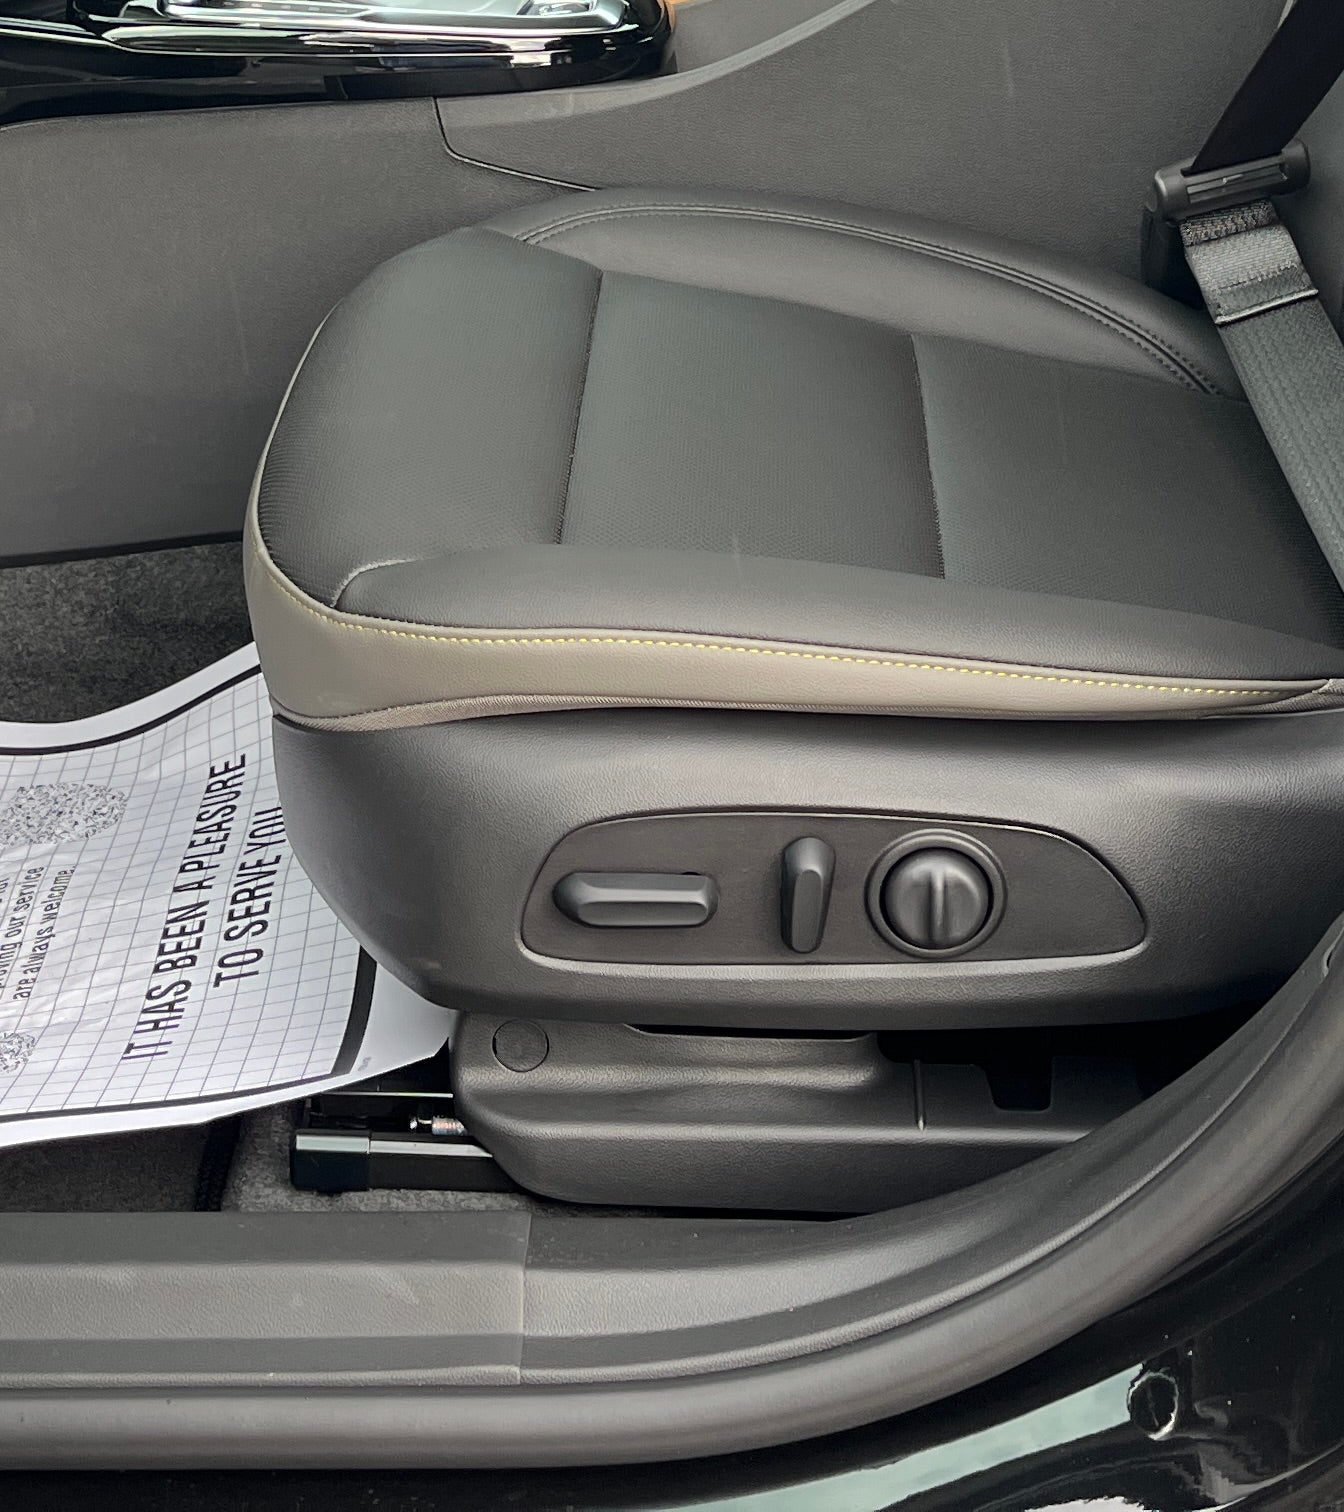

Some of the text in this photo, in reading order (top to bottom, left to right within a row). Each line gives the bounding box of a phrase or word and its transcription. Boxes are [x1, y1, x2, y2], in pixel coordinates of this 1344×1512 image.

[13, 867, 45, 912] service
[121, 754, 247, 1061] IT HAS BEEN A PLEASURE
[213, 807, 287, 988] TO SERVE YOU
[6, 916, 27, 938] our
[21, 926, 56, 974] always
[13, 978, 36, 1000] are
